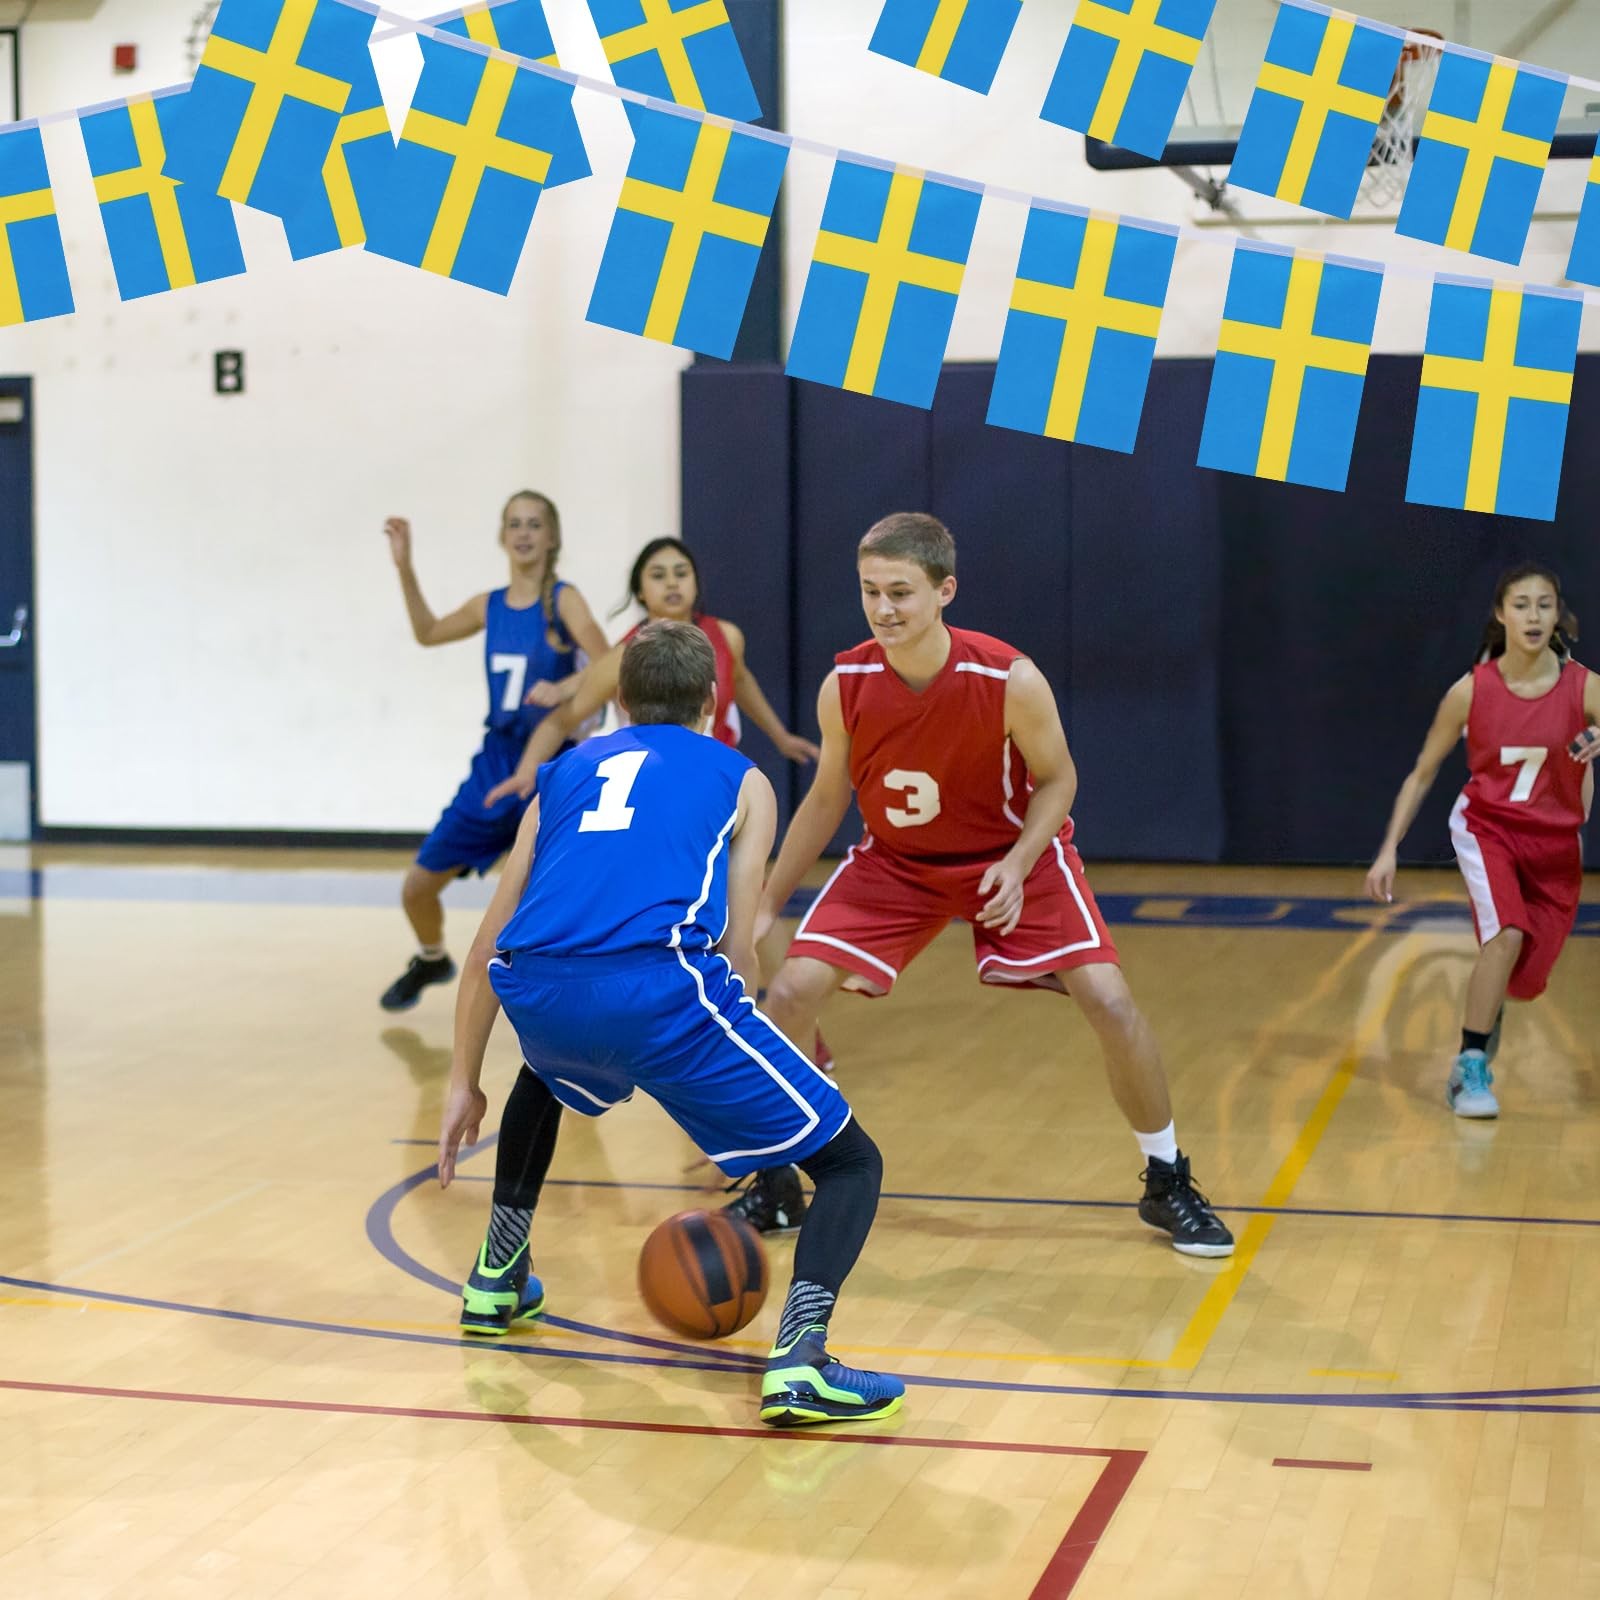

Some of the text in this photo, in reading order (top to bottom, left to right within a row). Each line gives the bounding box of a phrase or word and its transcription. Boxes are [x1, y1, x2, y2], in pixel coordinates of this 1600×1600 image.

[491, 653, 527, 711] 7
[578, 751, 648, 832] 1
[884, 769, 940, 827] 3
[1500, 746, 1548, 803] 7
